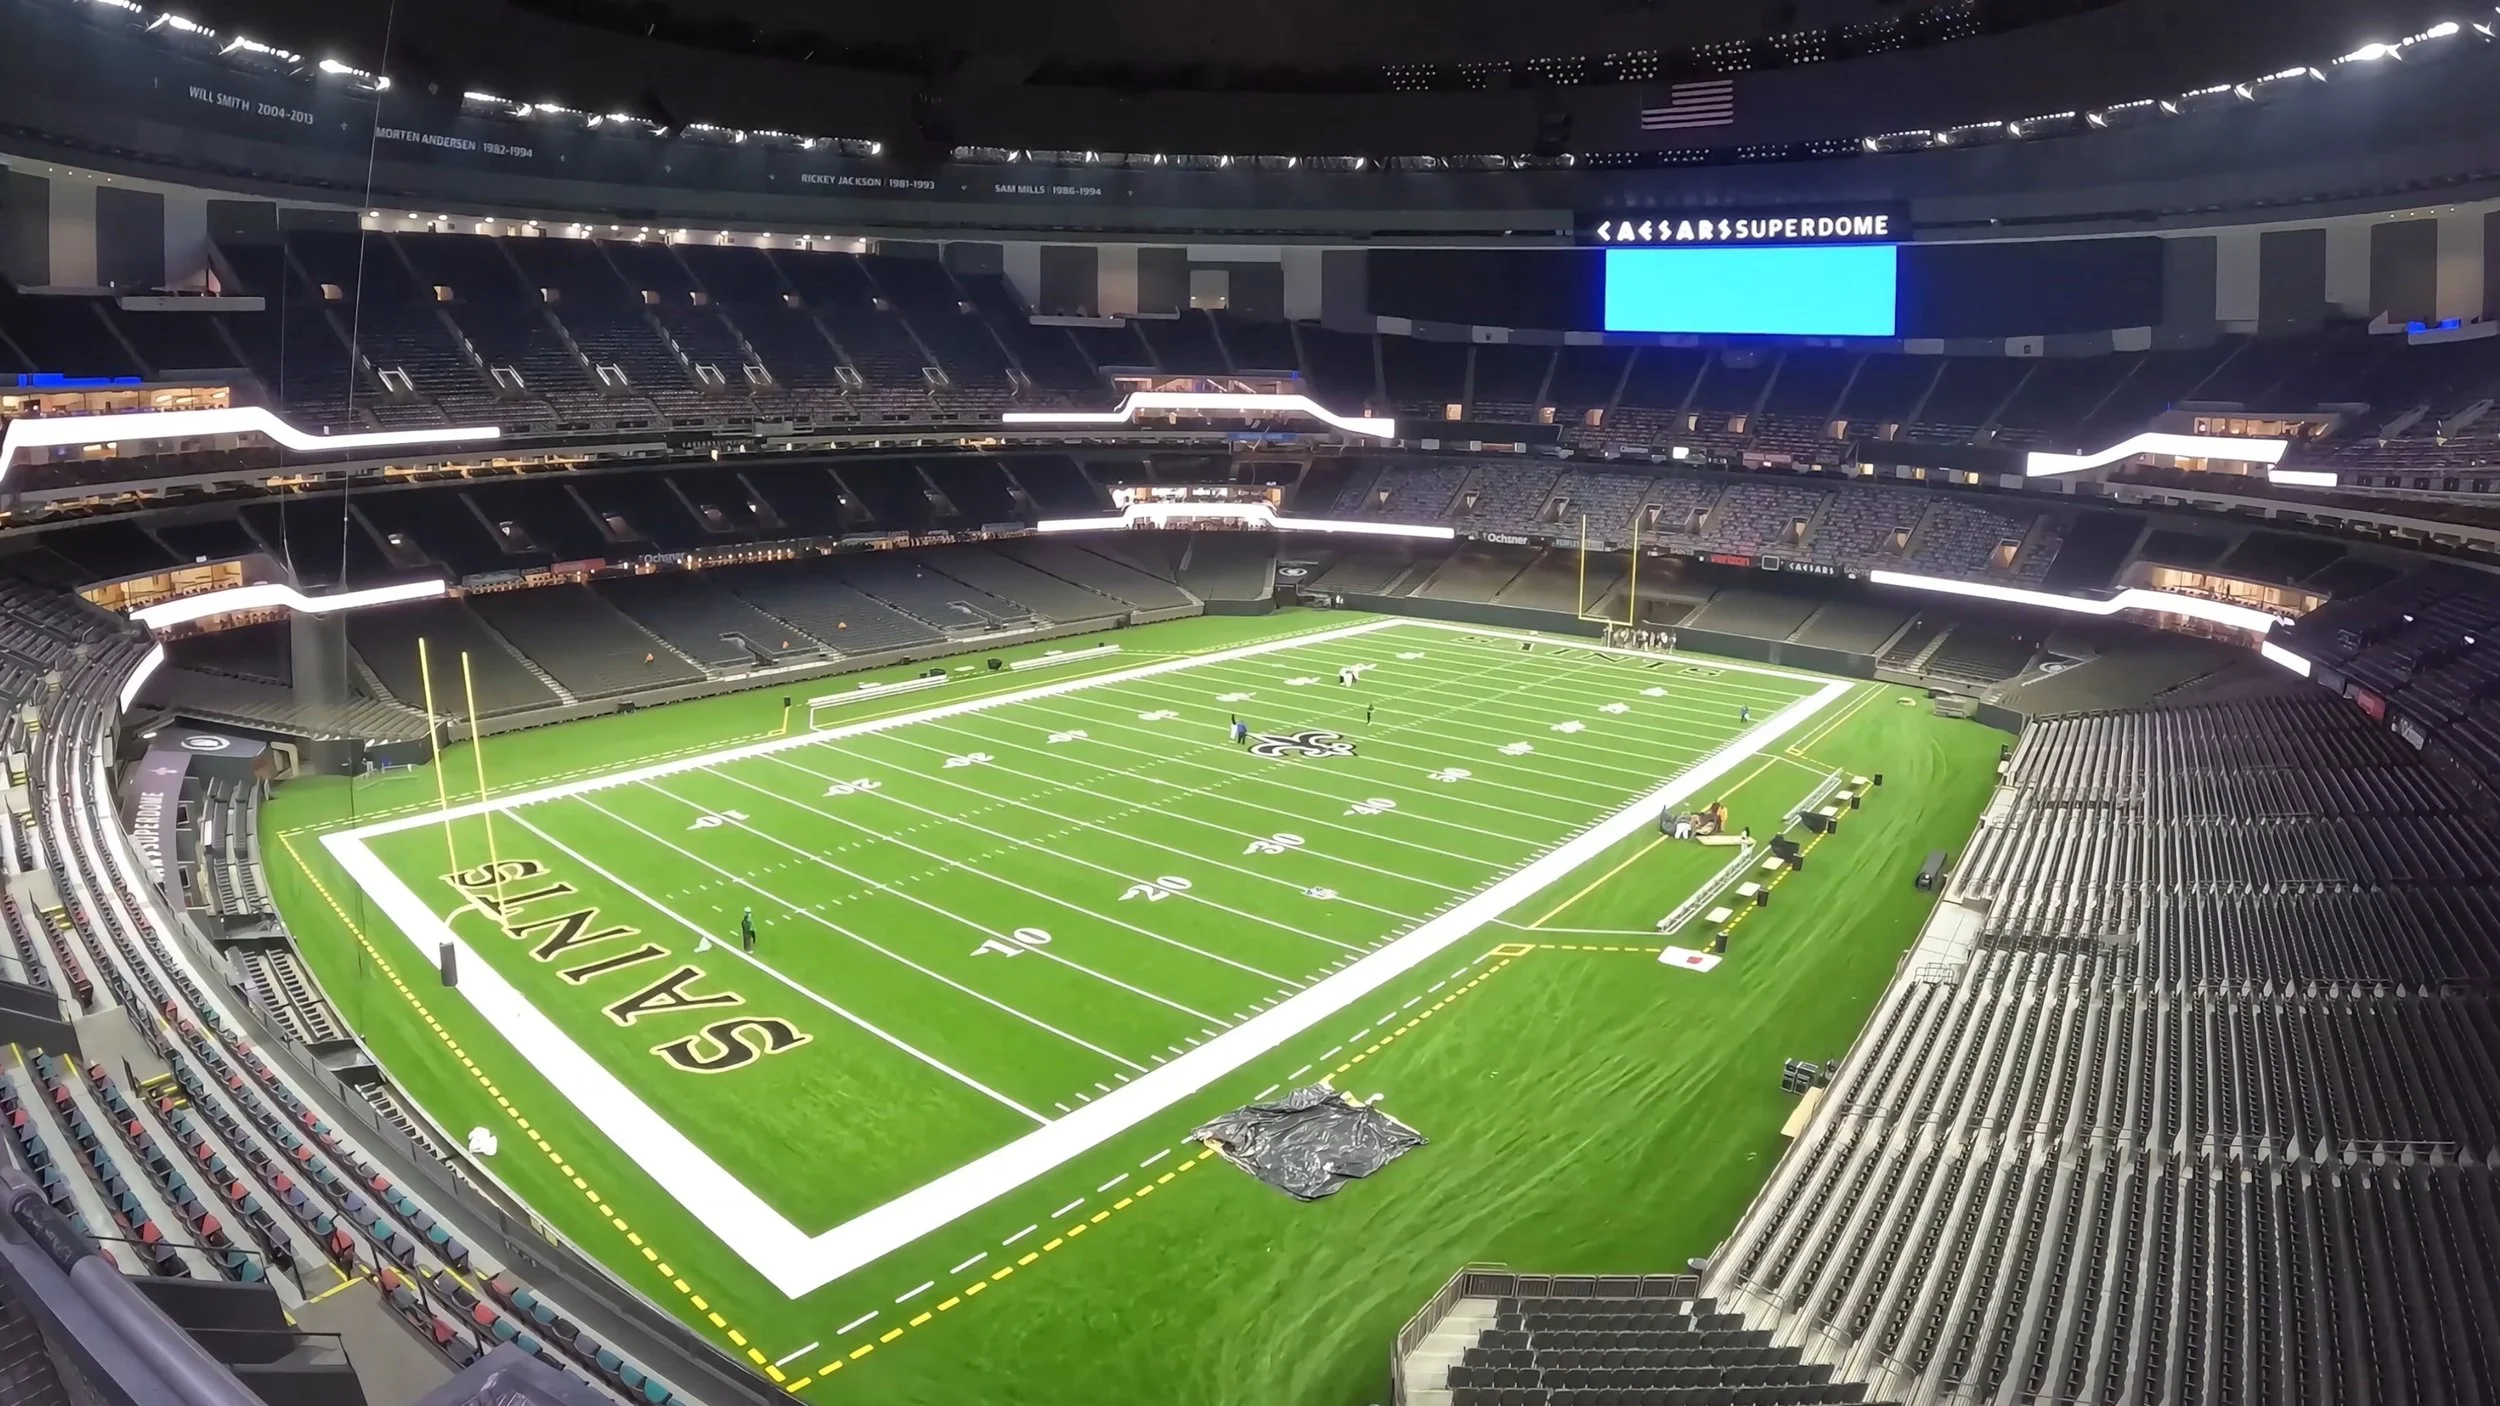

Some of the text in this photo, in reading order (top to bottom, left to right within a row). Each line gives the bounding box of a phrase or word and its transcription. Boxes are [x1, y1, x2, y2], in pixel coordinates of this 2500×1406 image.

[189, 85, 314, 125] WILL SMITH 2004-2013
[375, 127, 420, 143] MORTEN
[421, 134, 476, 150] ANDERSEN
[801, 174, 935, 189] RICKEY JACKSON 1981-1993
[995, 184, 1102, 196] SAM MILLS 1986-1994
[1735, 215, 1889, 239] SUPERDOME
[1487, 533, 1528, 544] Ochsner
[1789, 562, 1834, 575] CAESARS
[134, 791, 164, 850] SUPERDOME
[1249, 833, 1305, 854] 30
[1128, 875, 1192, 901] 20
[981, 927, 1052, 958] 10
[439, 858, 813, 1074] SAINTS
